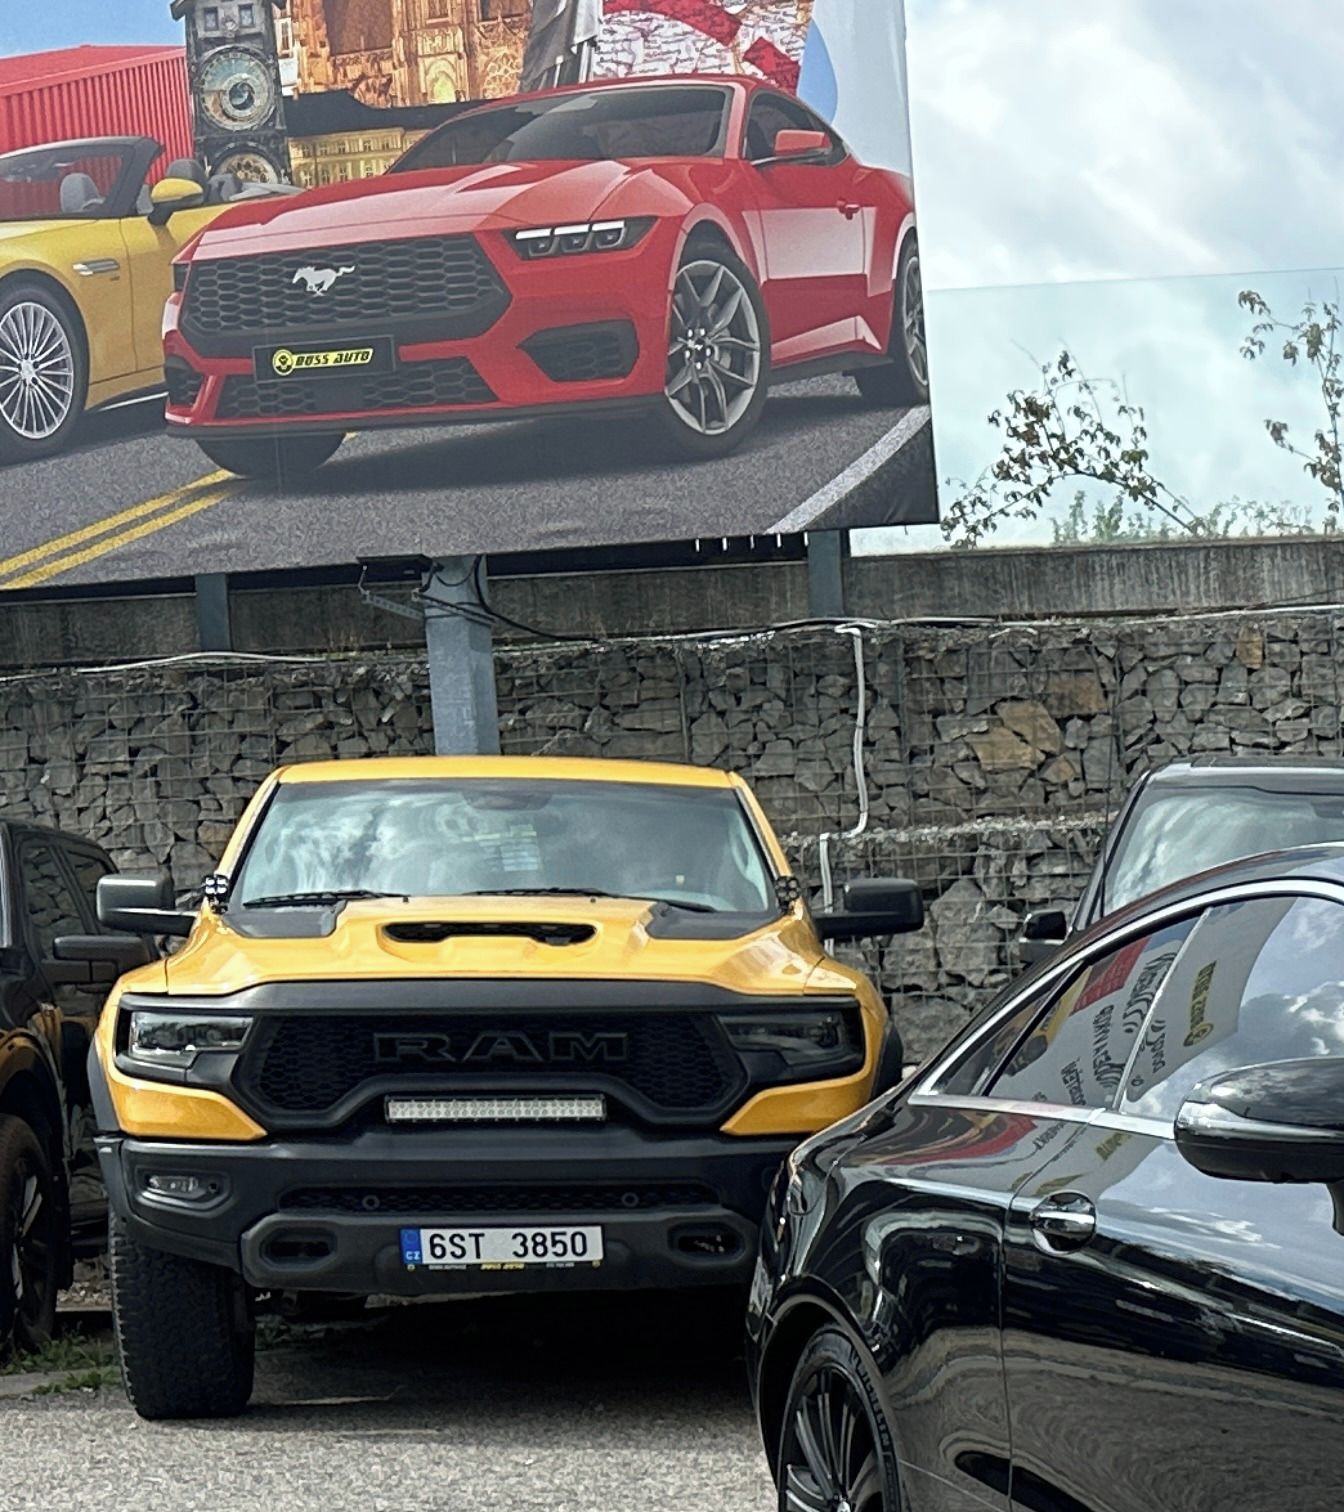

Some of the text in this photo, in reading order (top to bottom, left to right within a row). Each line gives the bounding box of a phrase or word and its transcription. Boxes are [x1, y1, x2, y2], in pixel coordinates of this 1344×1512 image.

[295, 350, 370, 366] BOSS AUTO
[374, 1032, 628, 1062] RAM
[405, 1251, 421, 1260] CZ
[429, 1231, 588, 1259] 6ST 3850
